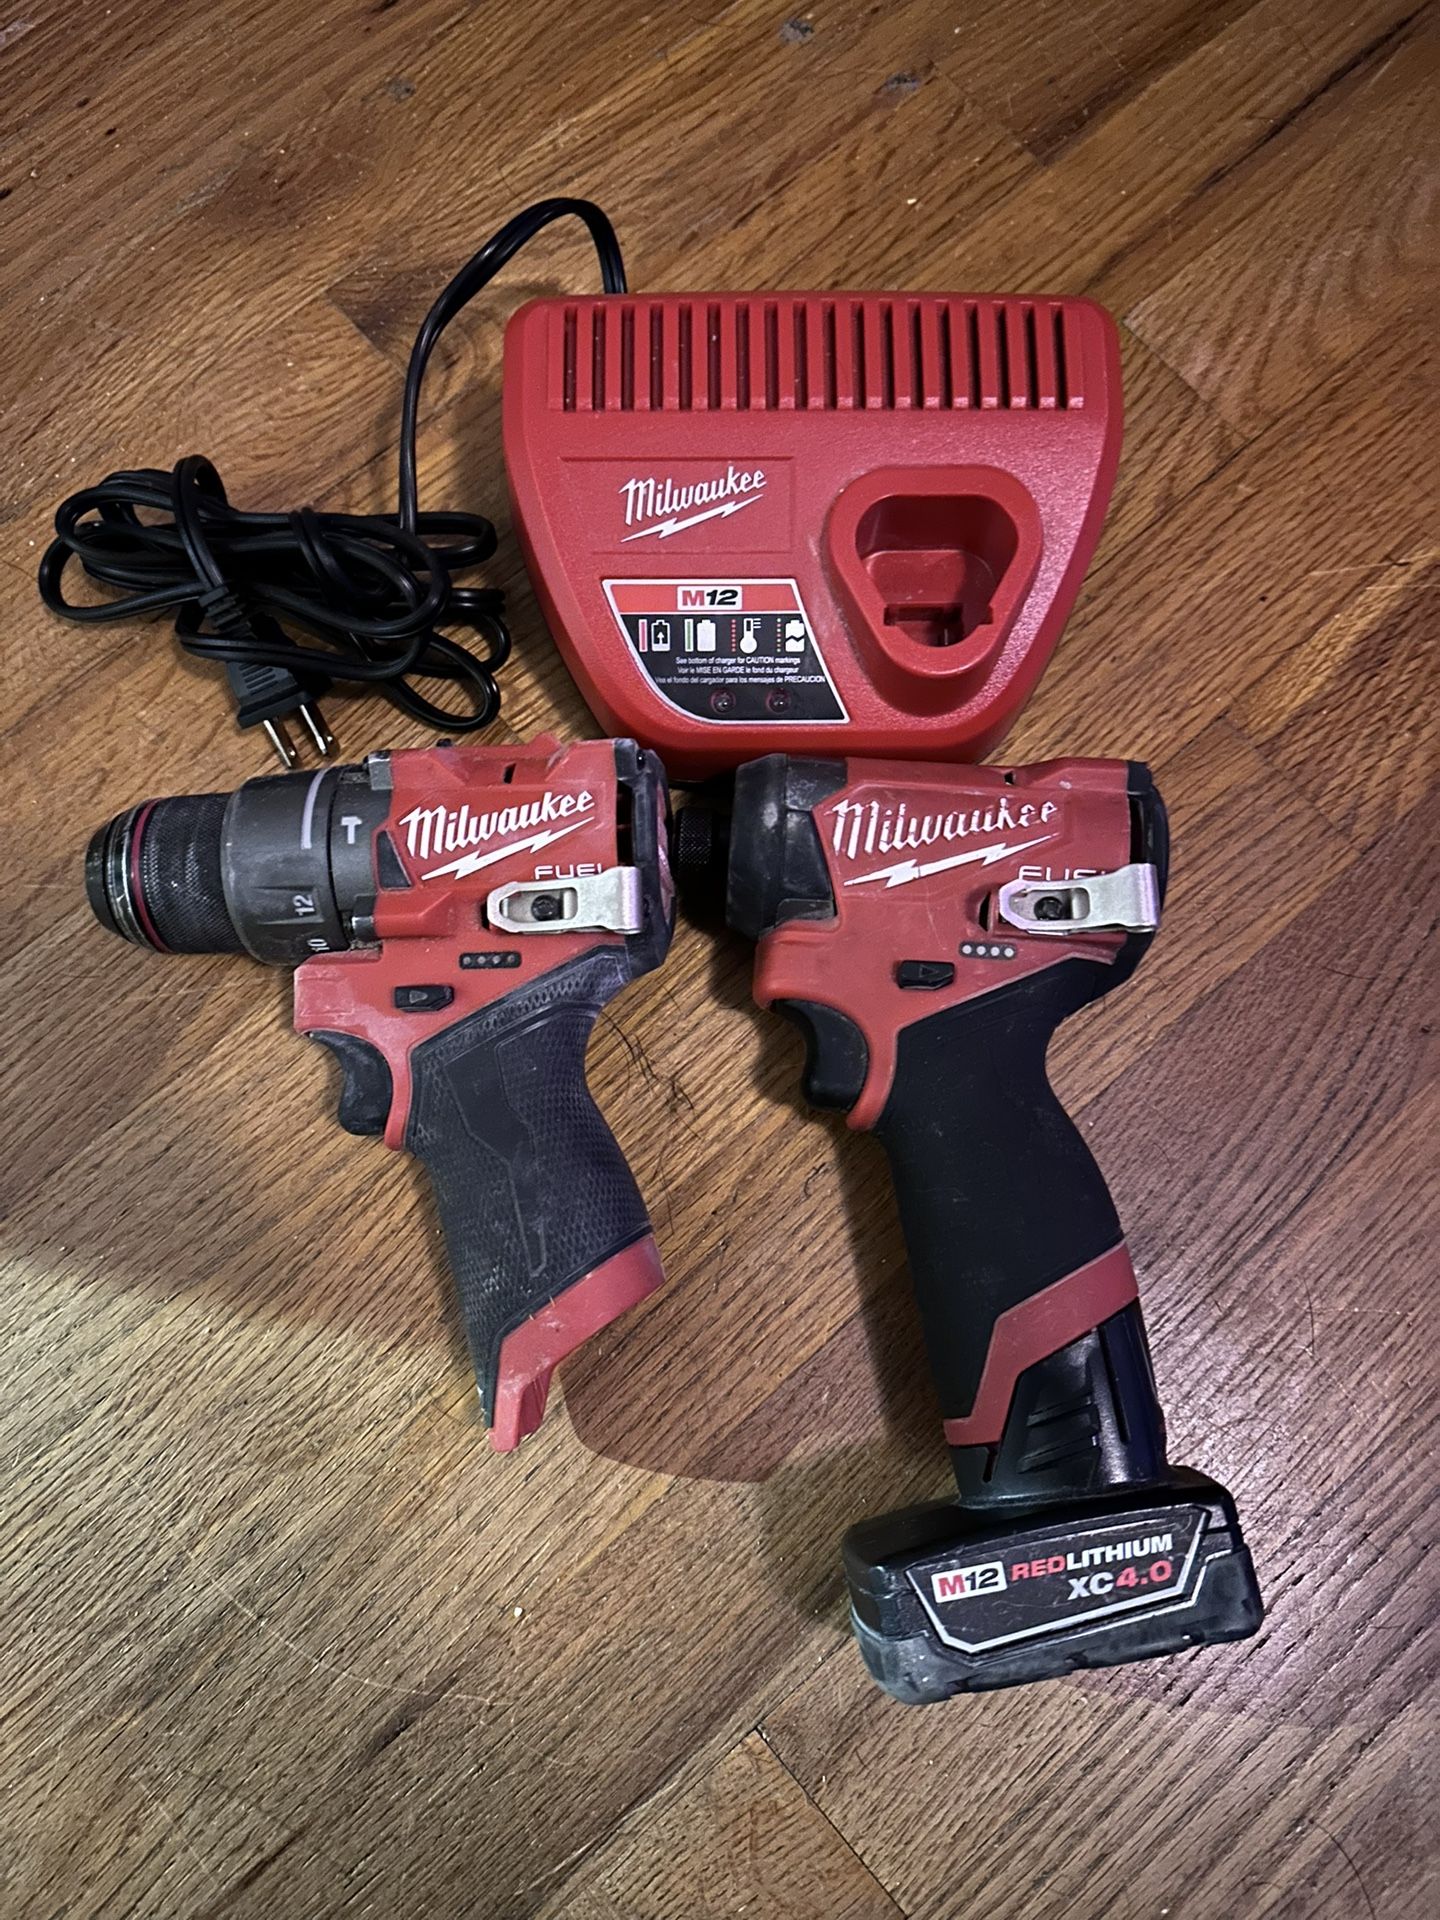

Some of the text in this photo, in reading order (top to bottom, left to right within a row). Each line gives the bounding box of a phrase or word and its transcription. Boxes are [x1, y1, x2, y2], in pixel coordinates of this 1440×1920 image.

[618, 465, 767, 526] Milwaukee
[681, 589, 738, 606] M12
[675, 656, 687, 664] See
[737, 656, 745, 664] for
[745, 656, 774, 664] CAUTION
[695, 666, 712, 674] MISE
[712, 666, 722, 674] EN
[722, 666, 744, 674] GARDE
[399, 790, 595, 859] Milwaukee
[824, 797, 1058, 860] Milwaukee
[292, 894, 316, 917] 12
[307, 938, 331, 953] 10
[938, 1533, 1174, 1597] M12 REDLITHIUM
[1067, 1560, 1174, 1600] XC4.0
